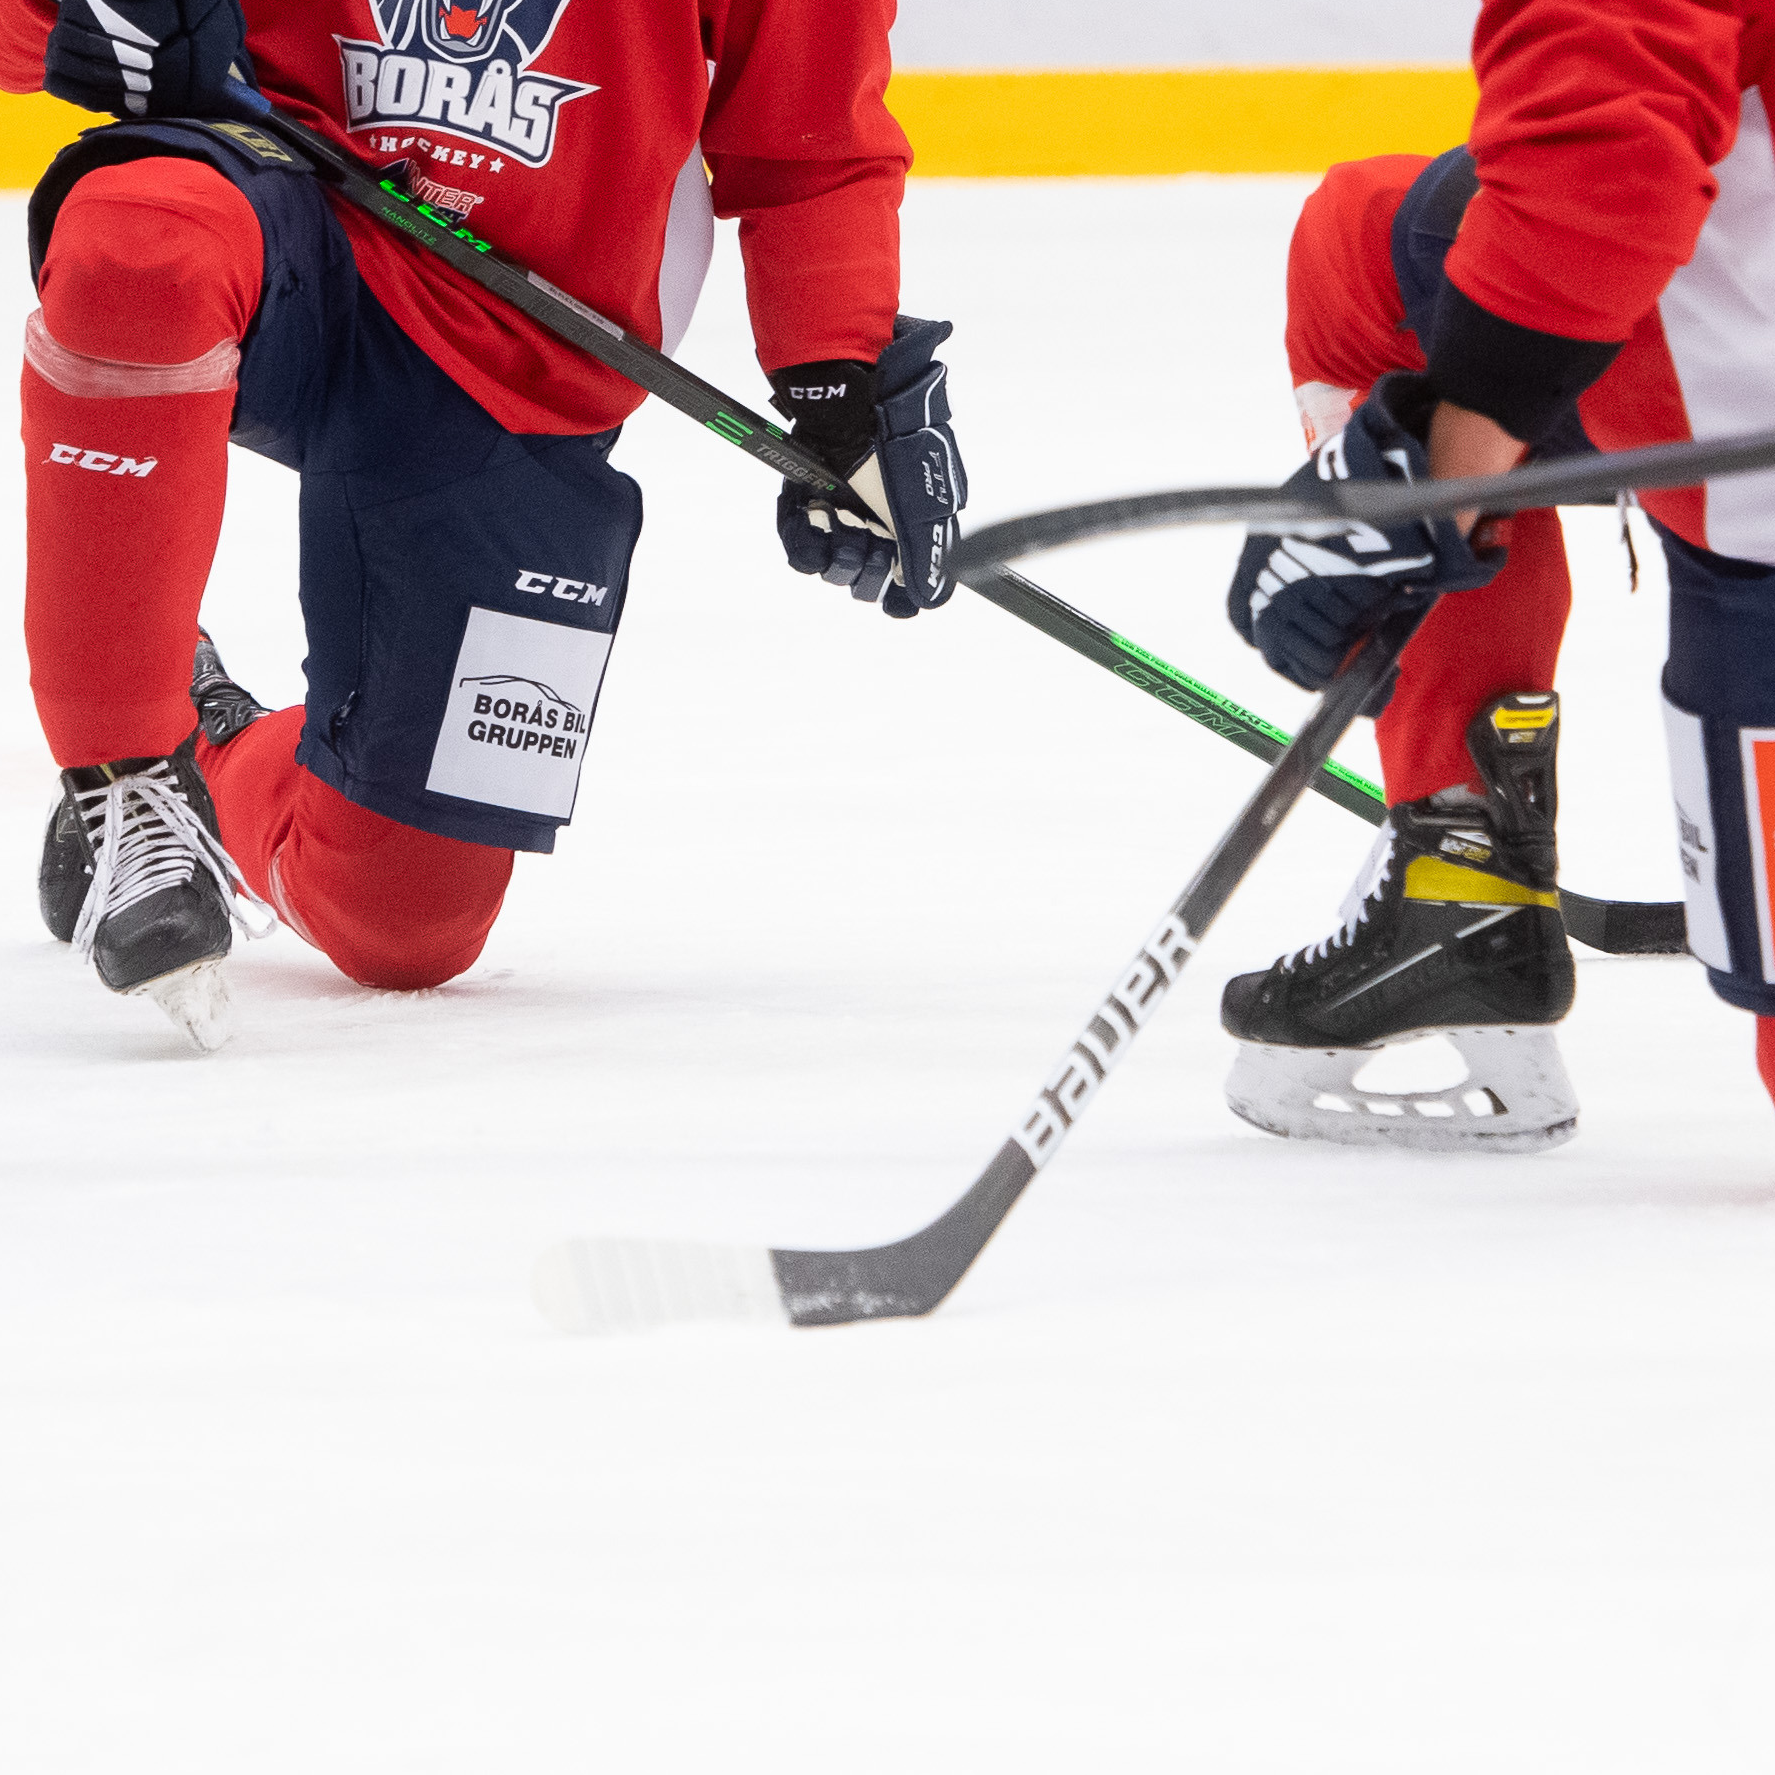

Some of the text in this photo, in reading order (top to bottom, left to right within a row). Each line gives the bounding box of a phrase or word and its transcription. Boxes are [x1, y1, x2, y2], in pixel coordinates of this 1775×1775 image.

[348, 48, 558, 156] BORÅS
[379, 135, 485, 170] HOCKEY
[789, 383, 847, 400] CCM
[49, 442, 159, 478] CCM
[755, 442, 827, 491] TRIGGER
[922, 460, 935, 497] PRO
[927, 524, 944, 589] CCM
[514, 568, 608, 607] CCM
[473, 693, 586, 734] BORÅS BIL
[1113, 659, 1248, 738] CCM
[467, 719, 578, 760] GRUPPEN
